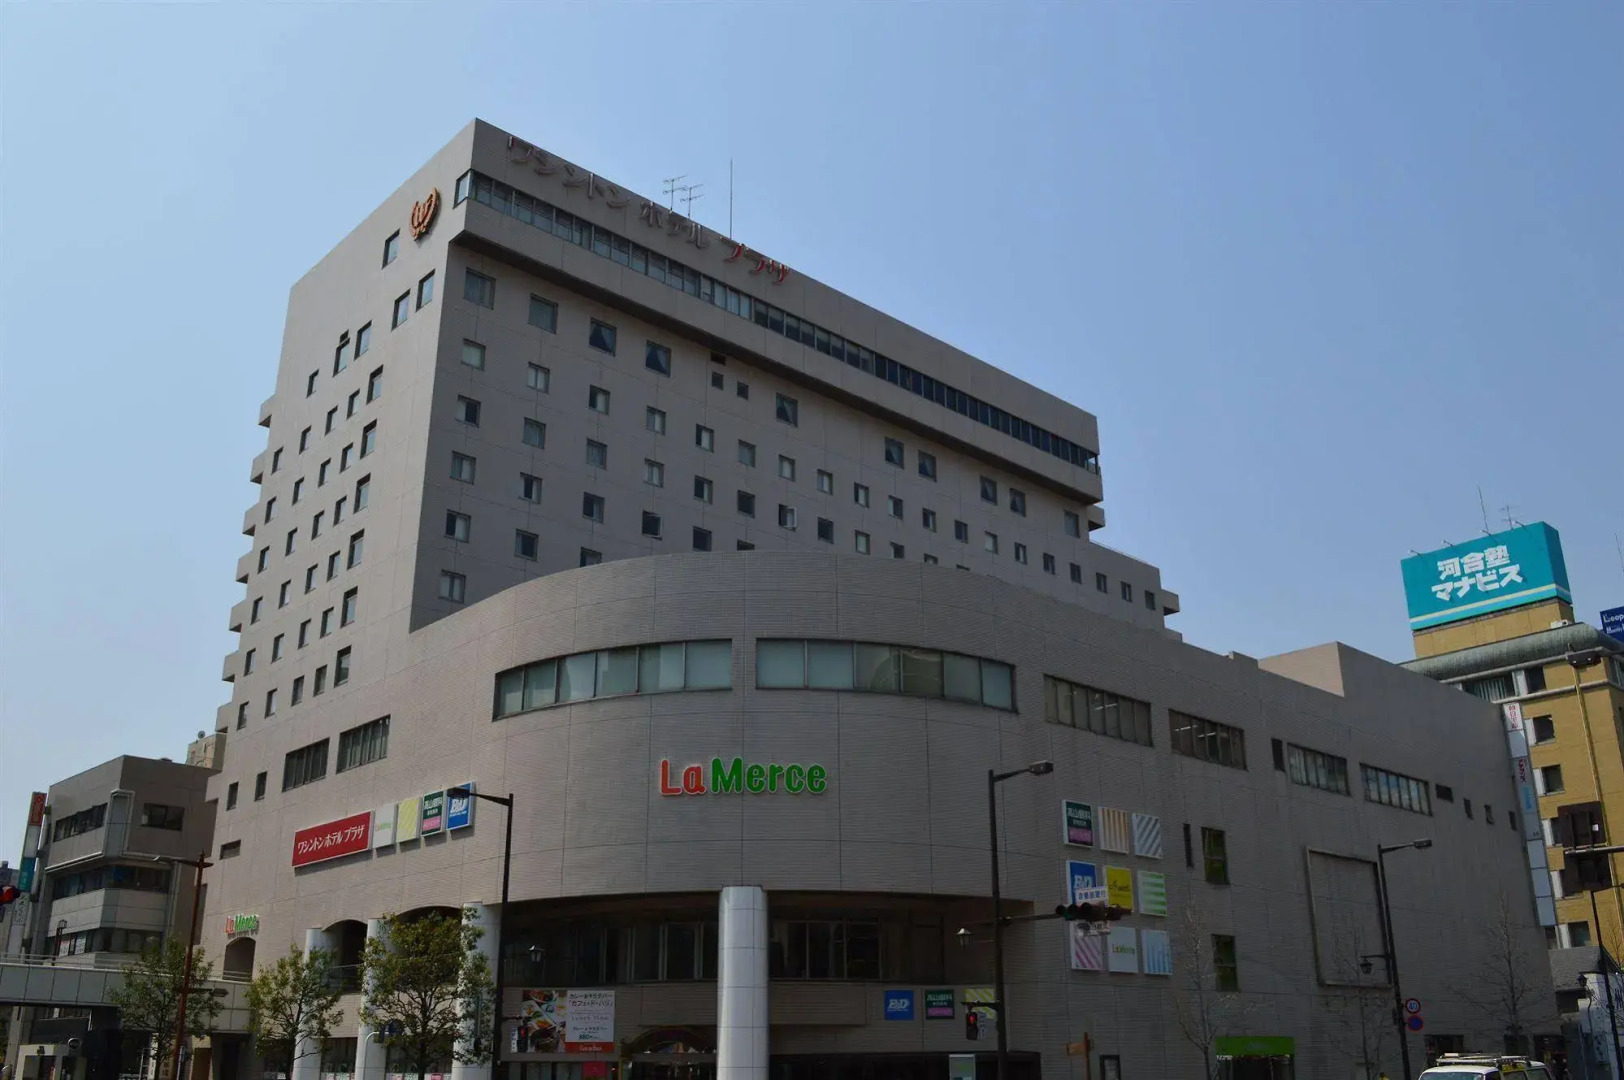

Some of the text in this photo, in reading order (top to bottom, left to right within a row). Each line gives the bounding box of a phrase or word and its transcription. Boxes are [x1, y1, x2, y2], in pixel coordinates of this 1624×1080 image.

[1437, 545, 1510, 580] 河合塾
[1431, 564, 1523, 601] マナビス
[660, 757, 826, 795] La Merce
[344, 825, 365, 843] プラザ
[1409, 1002, 1417, 1010] 40
